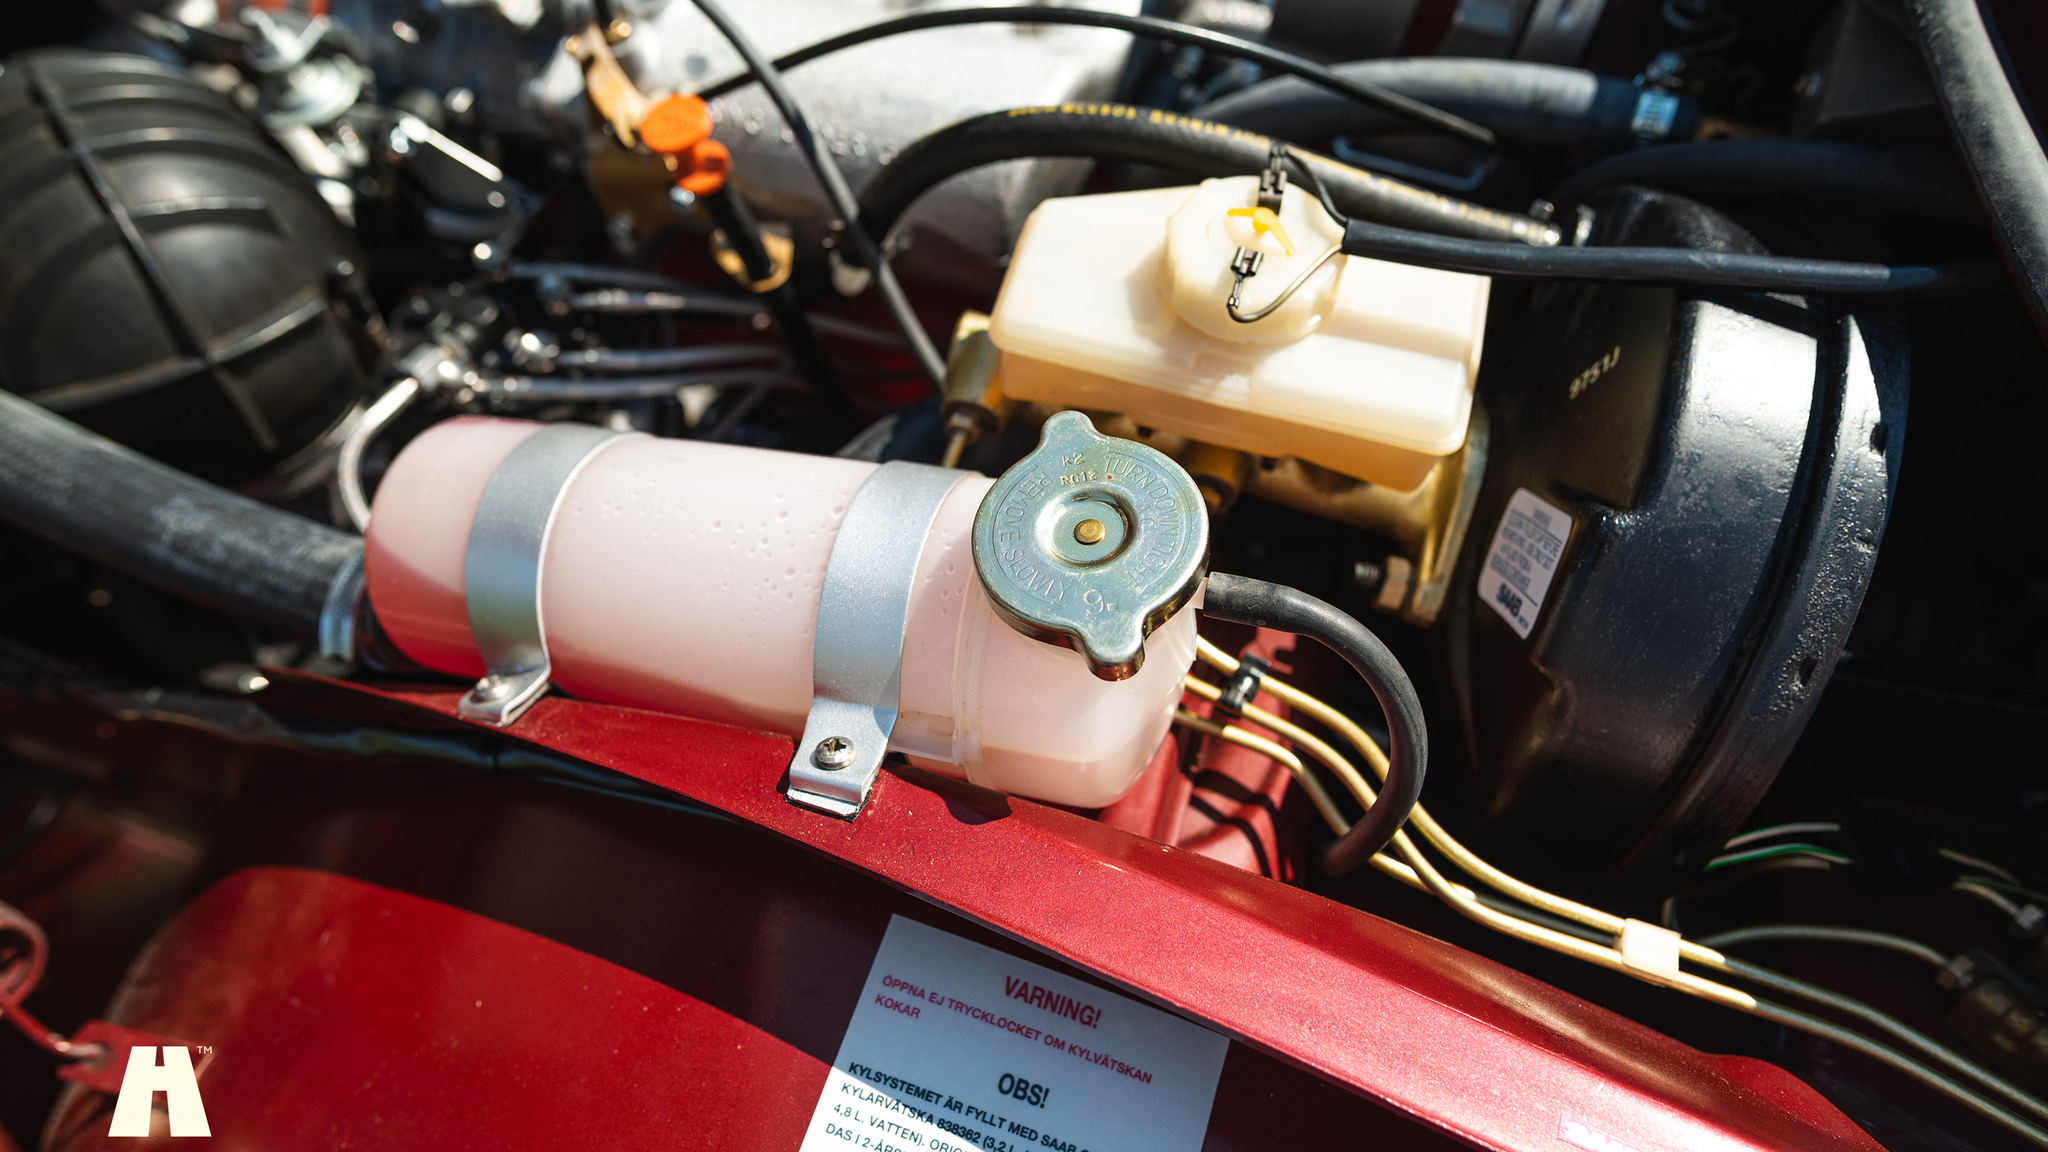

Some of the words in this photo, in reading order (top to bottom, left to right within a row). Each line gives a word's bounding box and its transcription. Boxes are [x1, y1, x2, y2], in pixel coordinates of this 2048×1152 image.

[1103, 455, 1158, 490] TURN
[998, 470, 1054, 542] REMOVE
[1148, 484, 1180, 538] DOWN
[1002, 547, 1074, 601] SLOWLY
[1127, 540, 1176, 590] TIGHT
[874, 993, 921, 1019] KOKAR
[882, 974, 926, 1000] ÖPPNA
[928, 991, 945, 1006] EJ
[947, 998, 1042, 1041] TRYCKLOCKET
[1043, 1034, 1066, 1051] OM
[1067, 1043, 1153, 1084] KYLVÄTSKAN
[1004, 975, 1103, 1029] VARNING!
[841, 1082, 934, 1126] KYLARVÄTSKA
[936, 1118, 981, 1144] 838362
[848, 1062, 944, 1105] KYLSYSTEMET
[943, 1095, 965, 1113] ÄR
[965, 1106, 1008, 1130] FYLLT
[1007, 1121, 1039, 1142] MED
[997, 1073, 1050, 1109] OBS!
[825, 1123, 853, 1142] DAS
[833, 1103, 853, 1118] 4,8
[854, 1112, 865, 1123] L.
[869, 1115, 926, 1147] VATTEN).
